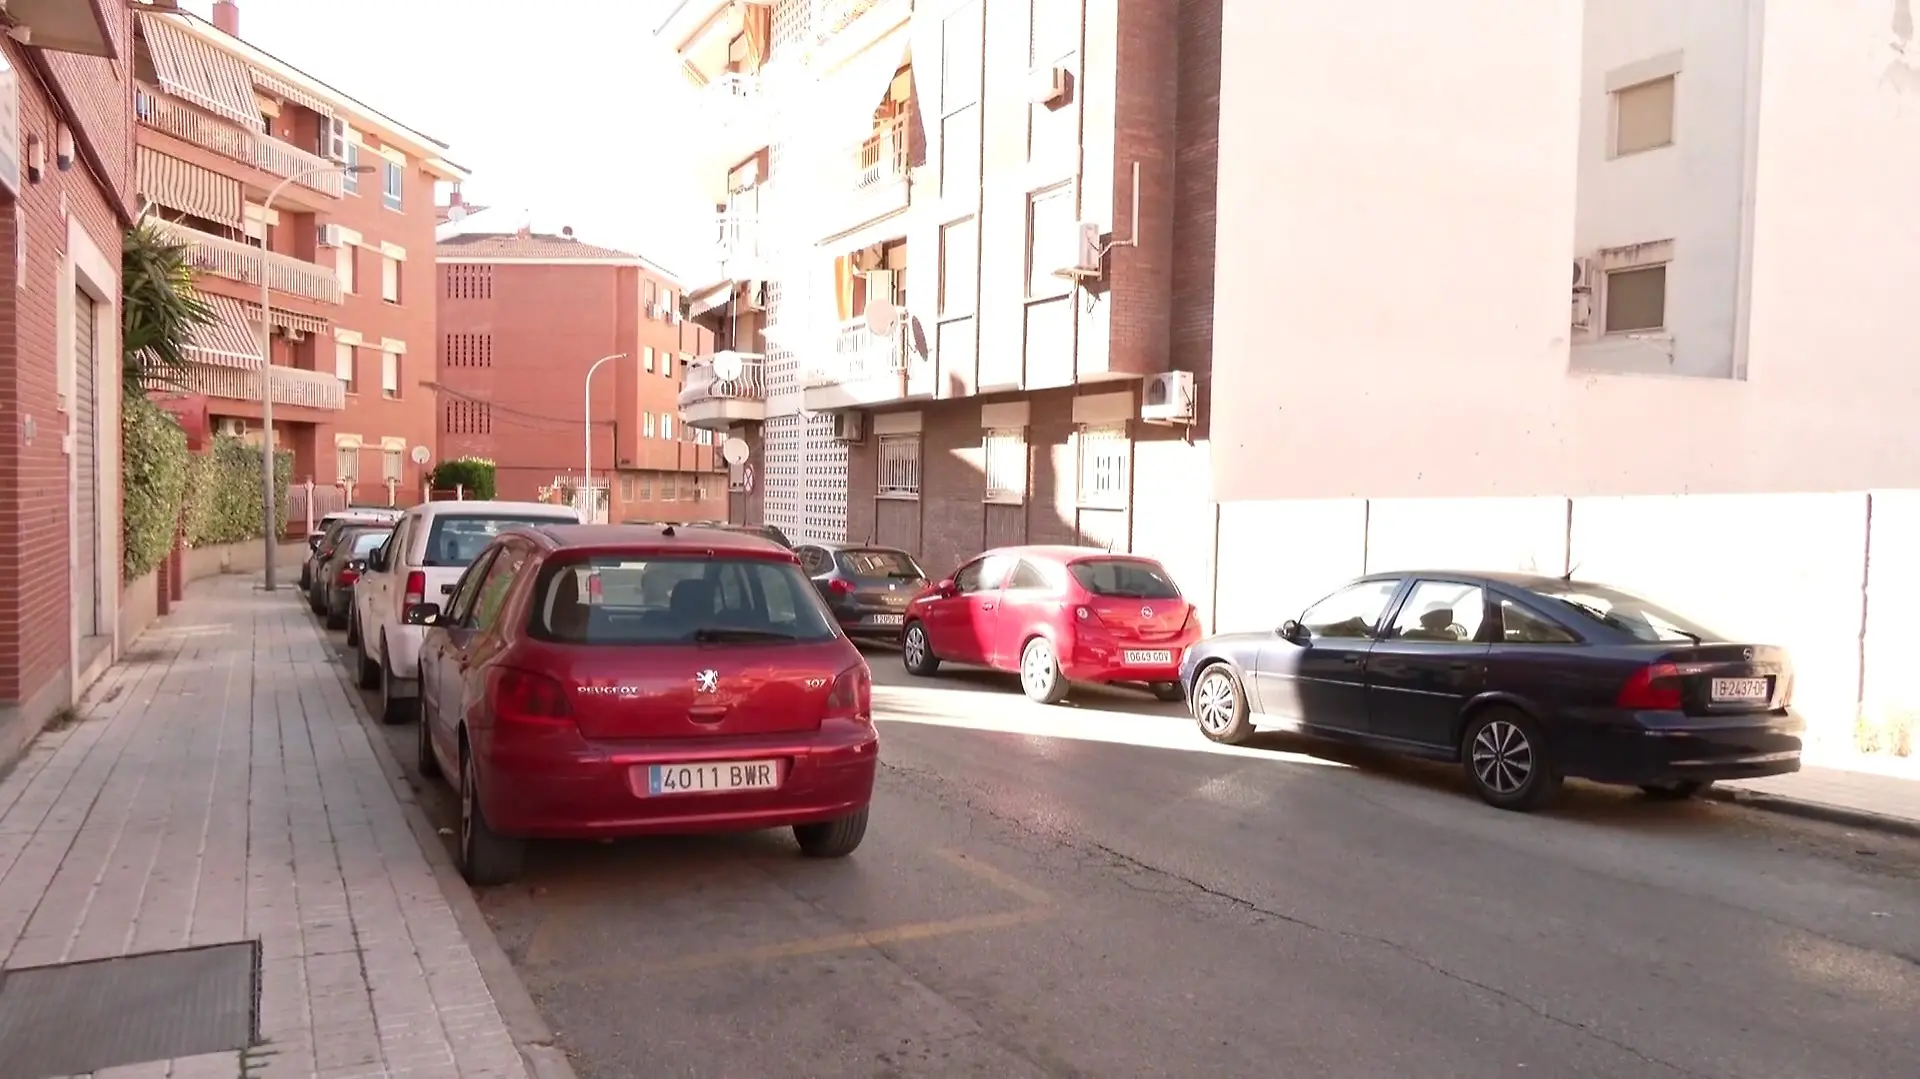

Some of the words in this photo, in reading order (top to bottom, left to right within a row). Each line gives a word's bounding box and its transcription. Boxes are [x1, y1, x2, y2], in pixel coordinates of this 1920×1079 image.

[805, 679, 827, 688] 307
[577, 686, 639, 695] PEUGEOT
[664, 766, 719, 790] 4011
[730, 764, 771, 787] BWR
